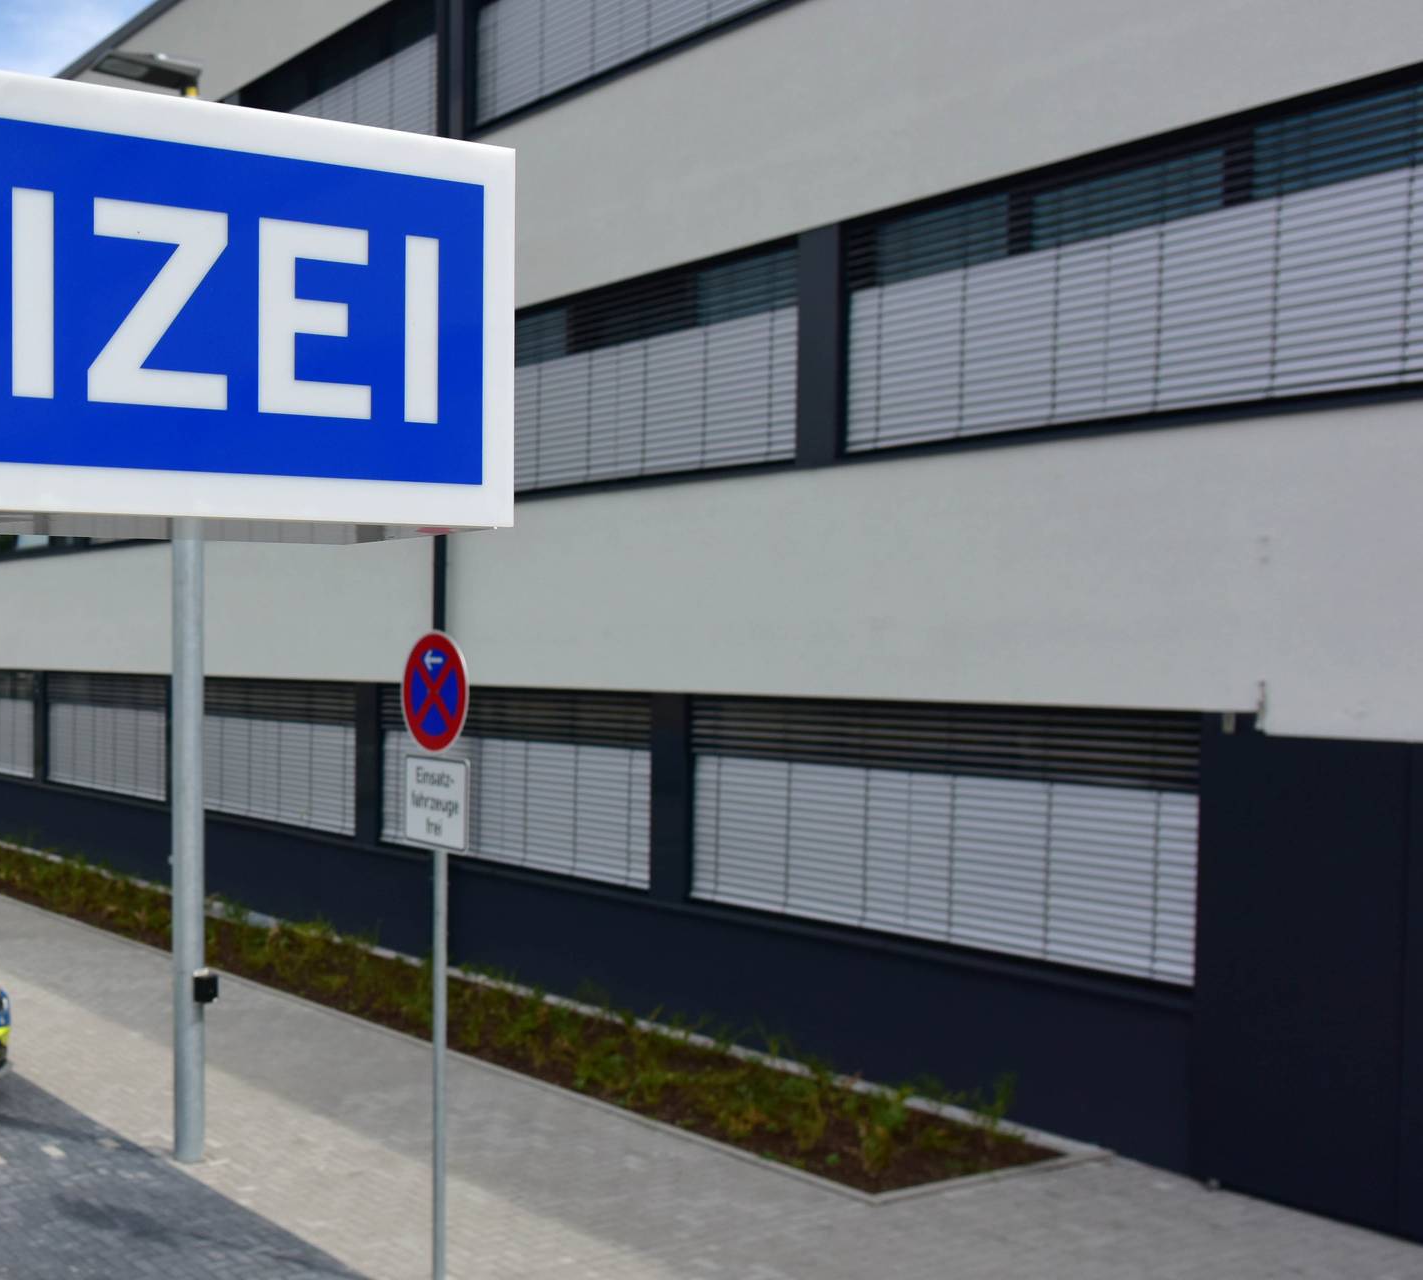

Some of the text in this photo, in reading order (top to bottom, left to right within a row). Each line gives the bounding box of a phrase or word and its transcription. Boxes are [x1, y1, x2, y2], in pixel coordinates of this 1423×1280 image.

[415, 766, 454, 787] Einsatz-
[411, 790, 459, 817] fahrzeuge
[425, 818, 442, 837] frei
